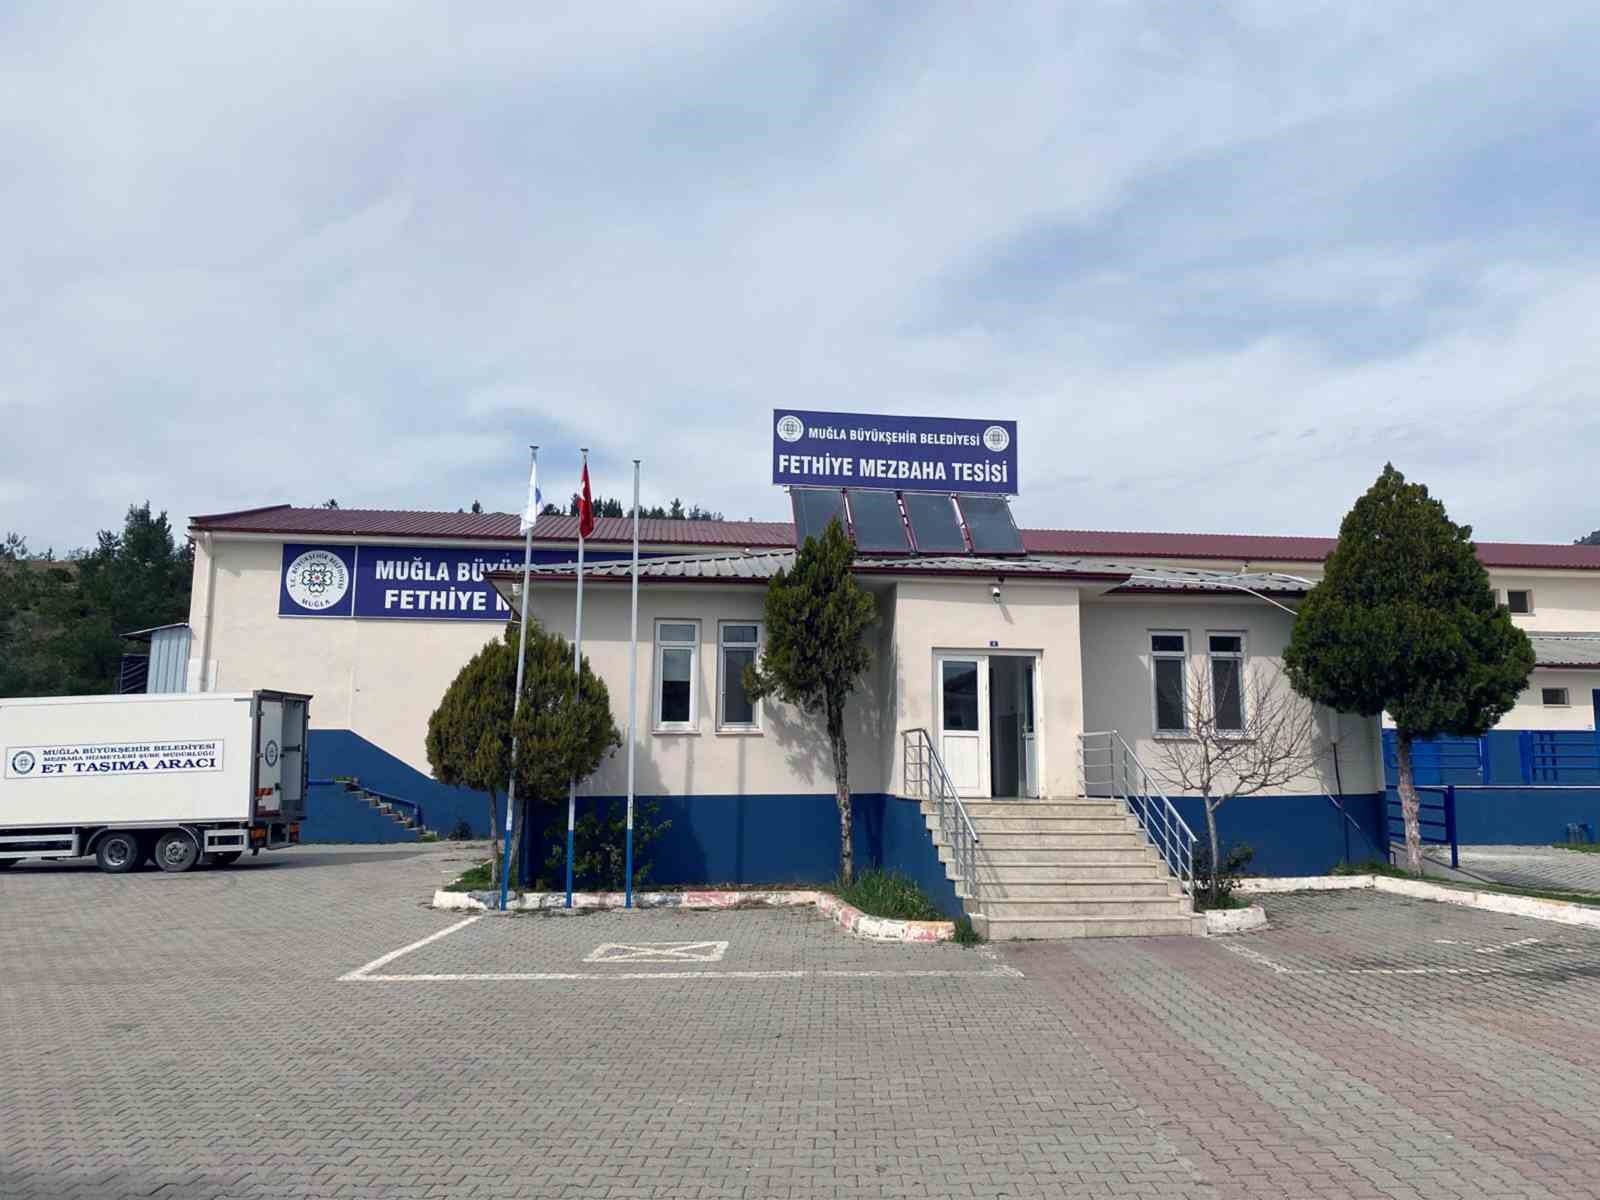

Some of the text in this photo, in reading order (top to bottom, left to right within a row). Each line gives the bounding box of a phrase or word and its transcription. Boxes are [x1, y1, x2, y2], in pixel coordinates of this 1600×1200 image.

[808, 426, 847, 440] MUĞLA
[849, 428, 917, 445] BÜYÜKŞEHİR
[920, 432, 980, 446] BELEDİYESİ
[778, 452, 1008, 483] FETHİYE MEZBAHA TESİSİ
[375, 556, 450, 581] MUĞLA
[384, 586, 487, 611] FETHİYE
[41, 763, 67, 773] ET
[154, 758, 216, 769] ARACI
